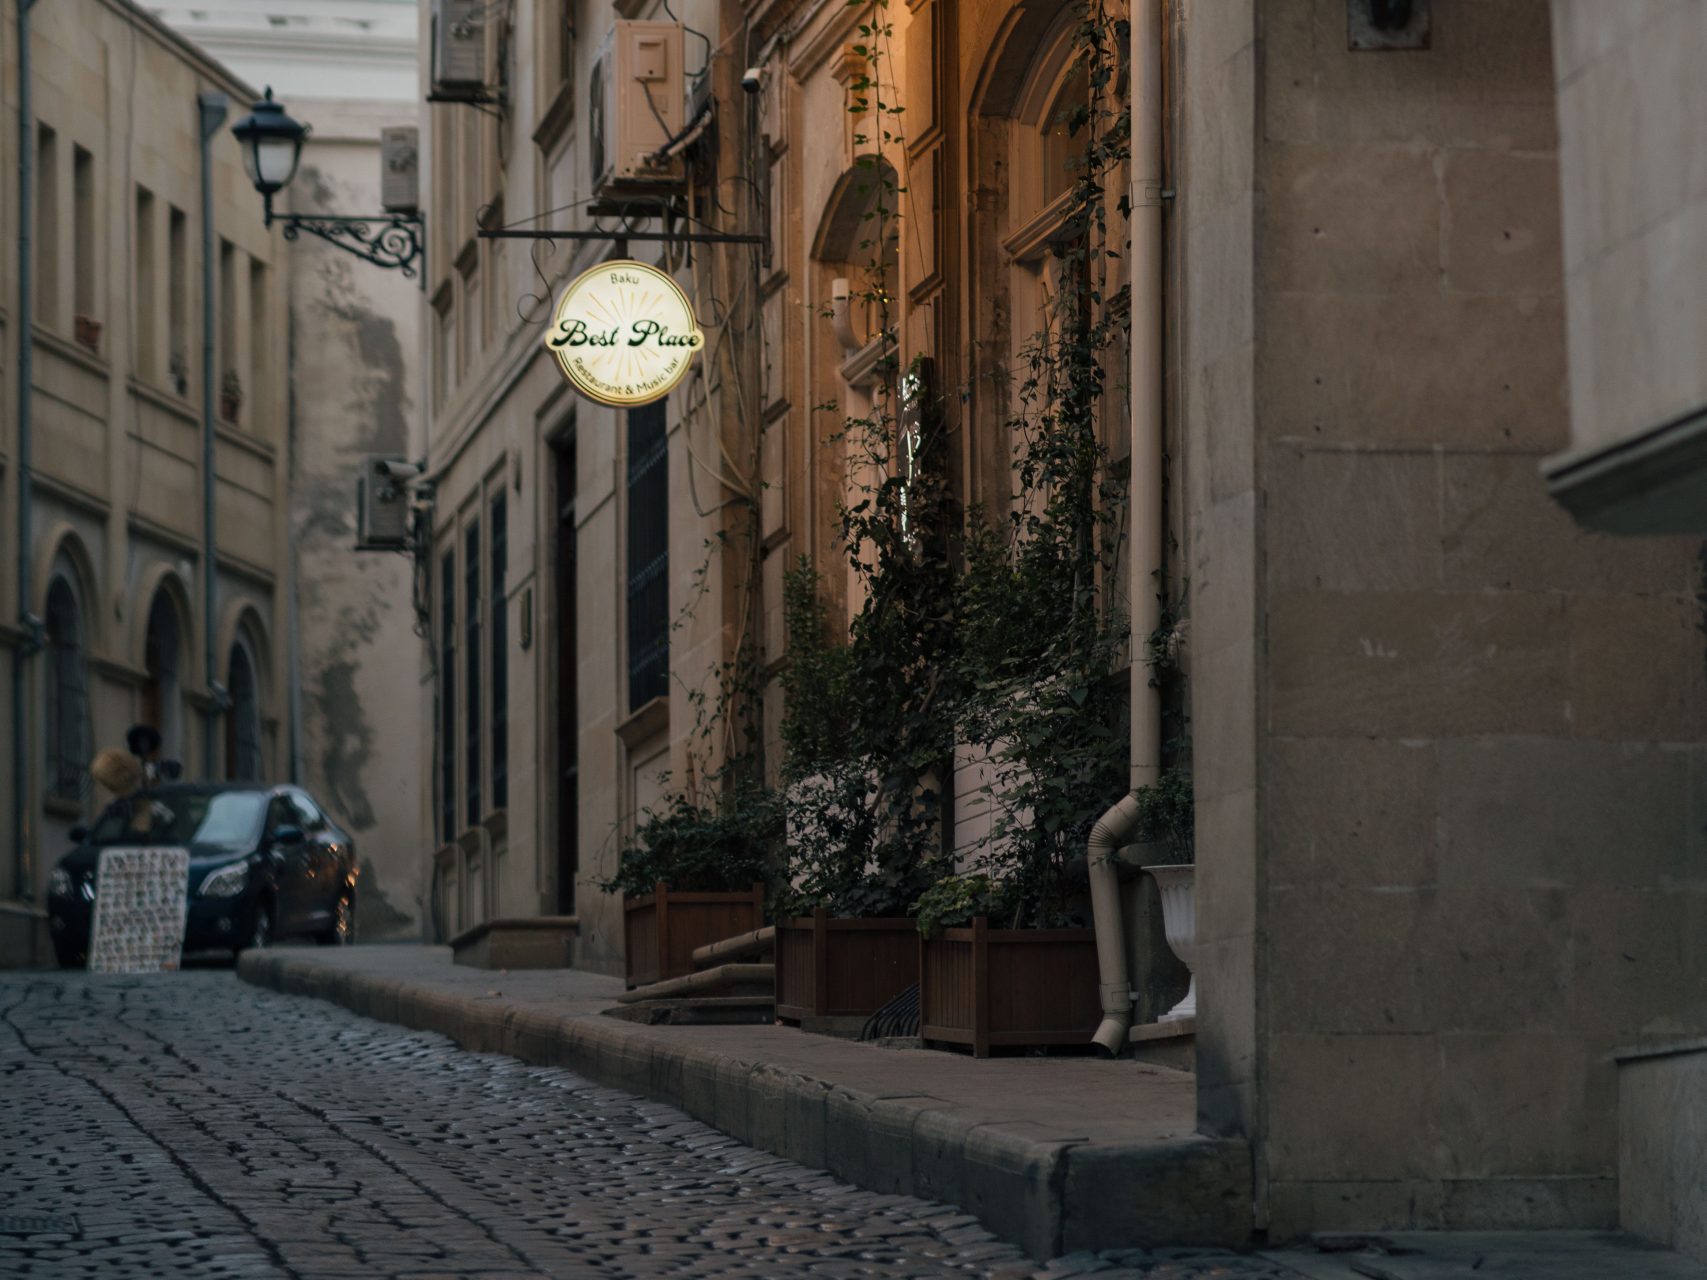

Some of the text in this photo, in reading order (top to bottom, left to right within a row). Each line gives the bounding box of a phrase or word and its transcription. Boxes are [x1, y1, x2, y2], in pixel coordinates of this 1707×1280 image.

[610, 272, 640, 285] Baku
[552, 319, 699, 347] Best Place
[573, 357, 679, 395] Restaurant & Music bar
